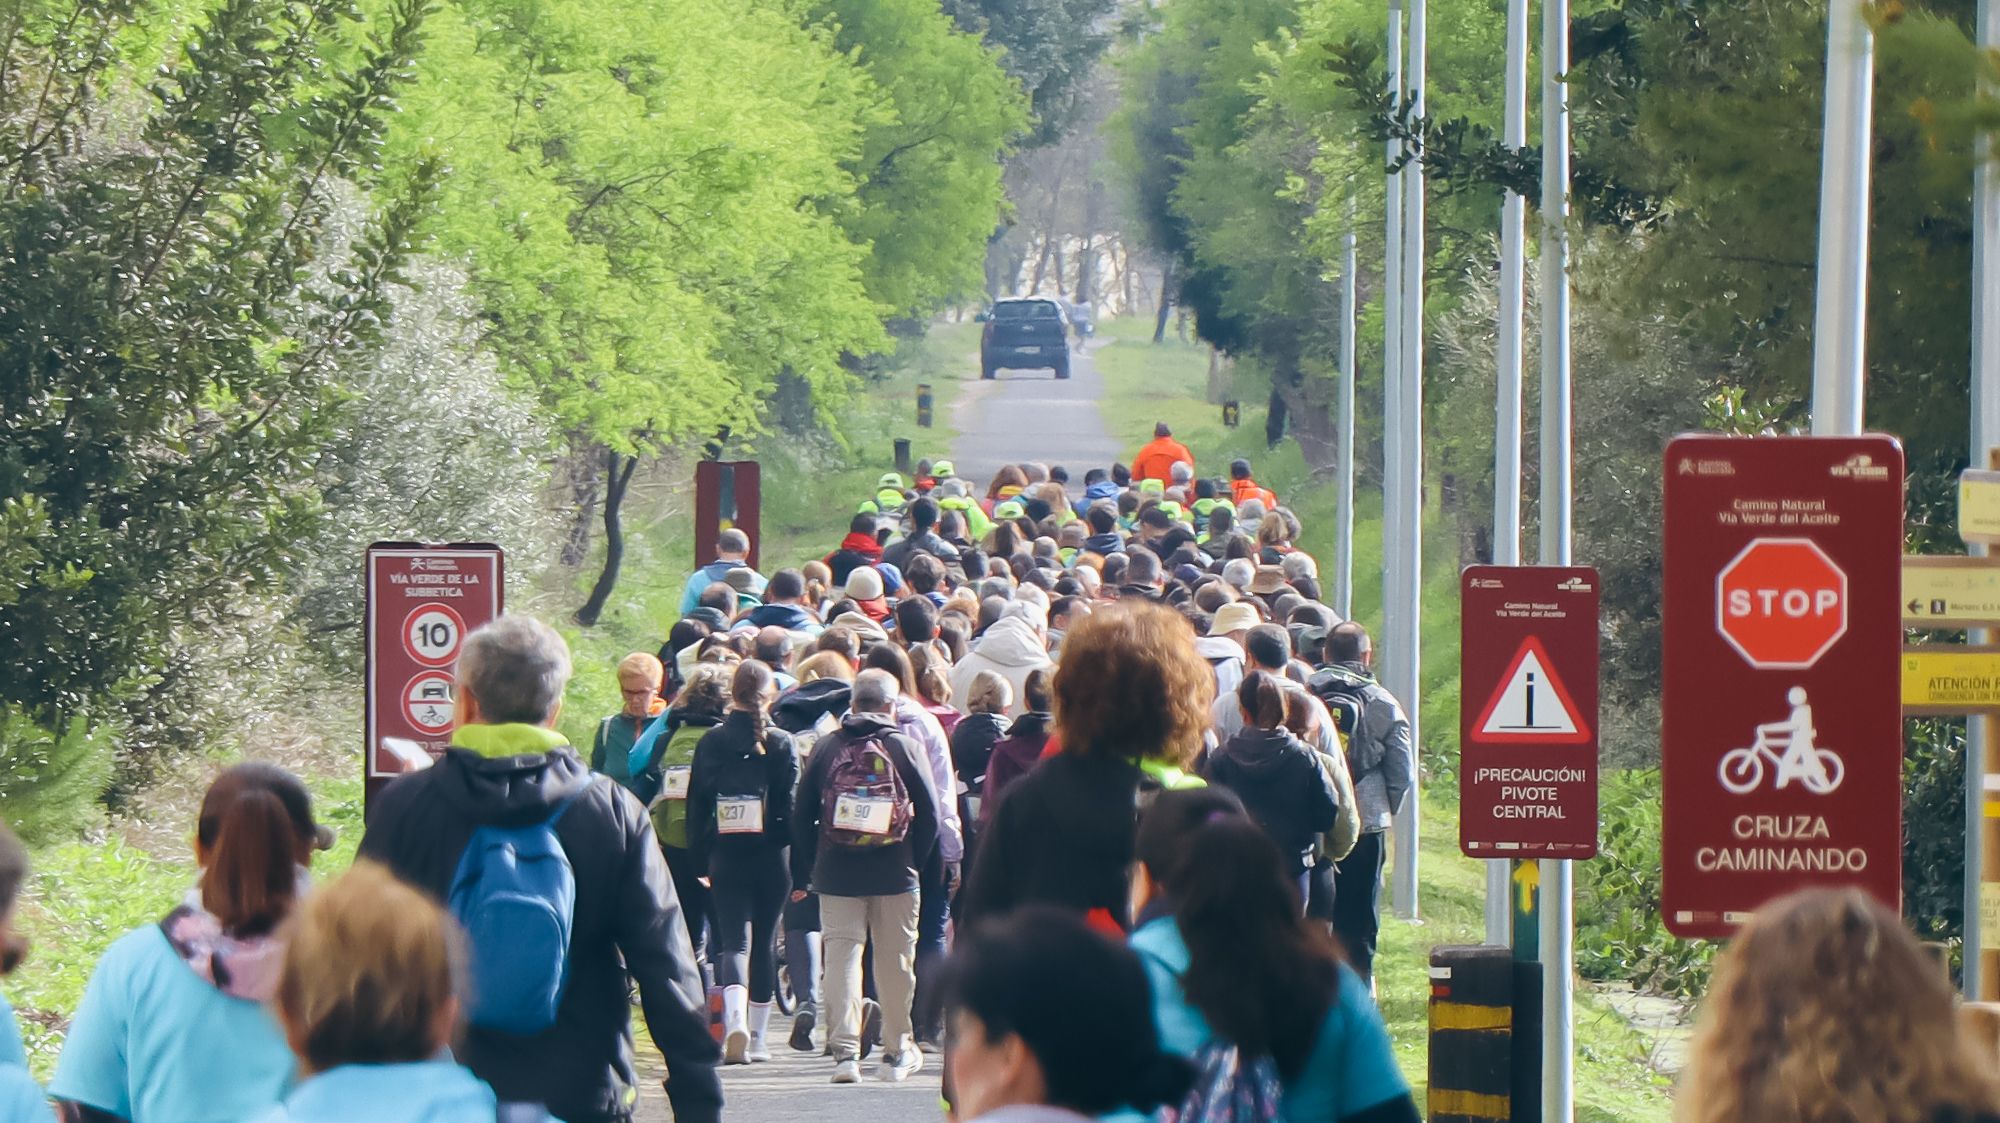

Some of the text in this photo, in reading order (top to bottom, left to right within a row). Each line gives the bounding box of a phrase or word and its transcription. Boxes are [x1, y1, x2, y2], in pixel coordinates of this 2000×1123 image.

[1733, 499, 1826, 511] Camino Natural
[1742, 512, 1776, 524] Verde
[1780, 513, 1799, 524] del
[1801, 513, 1841, 525] Aceite
[411, 574, 445, 584] VERDE
[448, 574, 462, 584] DE
[464, 574, 479, 584] LA
[1729, 589, 1839, 618] STOP
[418, 623, 450, 648] 10
[1474, 766, 1586, 785] ¡PRECAUCIÓN!
[1501, 786, 1558, 801] PIVOTE
[854, 804, 871, 819] 90
[1492, 805, 1567, 819] CENTRAL
[1734, 815, 1830, 838] CRUZA
[1697, 848, 1867, 872] CAMINANDO
